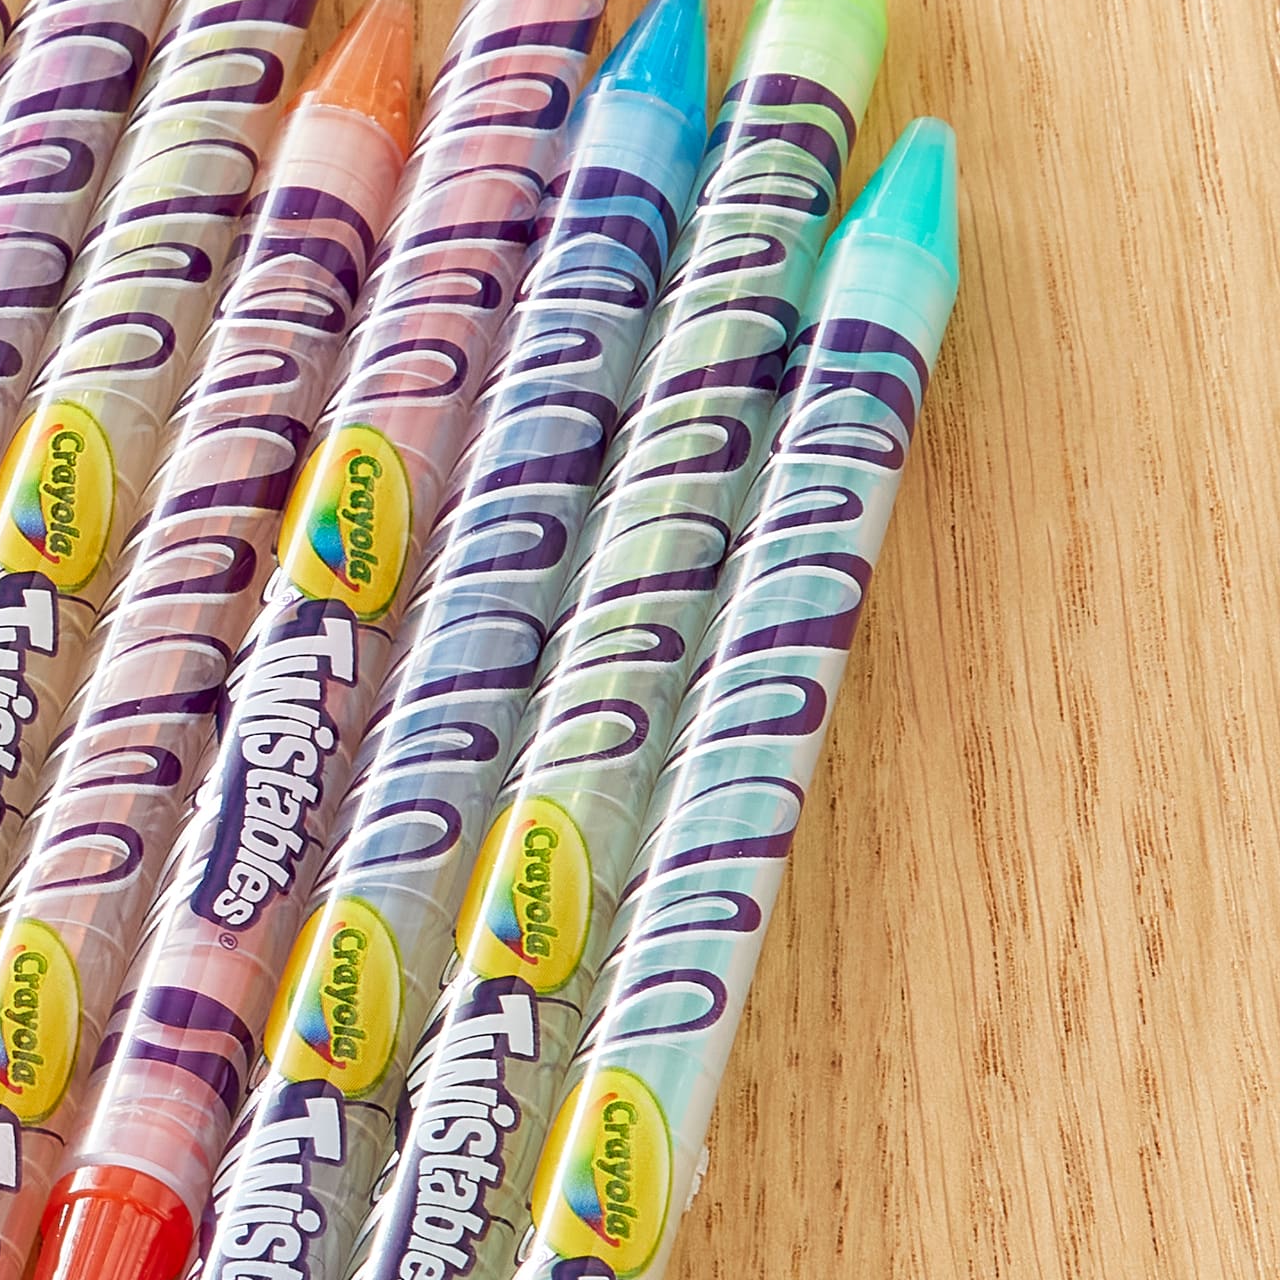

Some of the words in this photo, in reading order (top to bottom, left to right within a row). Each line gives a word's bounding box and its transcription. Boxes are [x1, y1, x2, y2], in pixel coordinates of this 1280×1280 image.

[40, 429, 86, 563] Crayola
[335, 455, 382, 588] Crayola
[214, 617, 354, 925] Twistables
[511, 825, 559, 960] Crayola
[0, 950, 48, 1087] Crayola
[319, 928, 368, 1060] Crayola
[592, 1099, 639, 1241] Crayola
